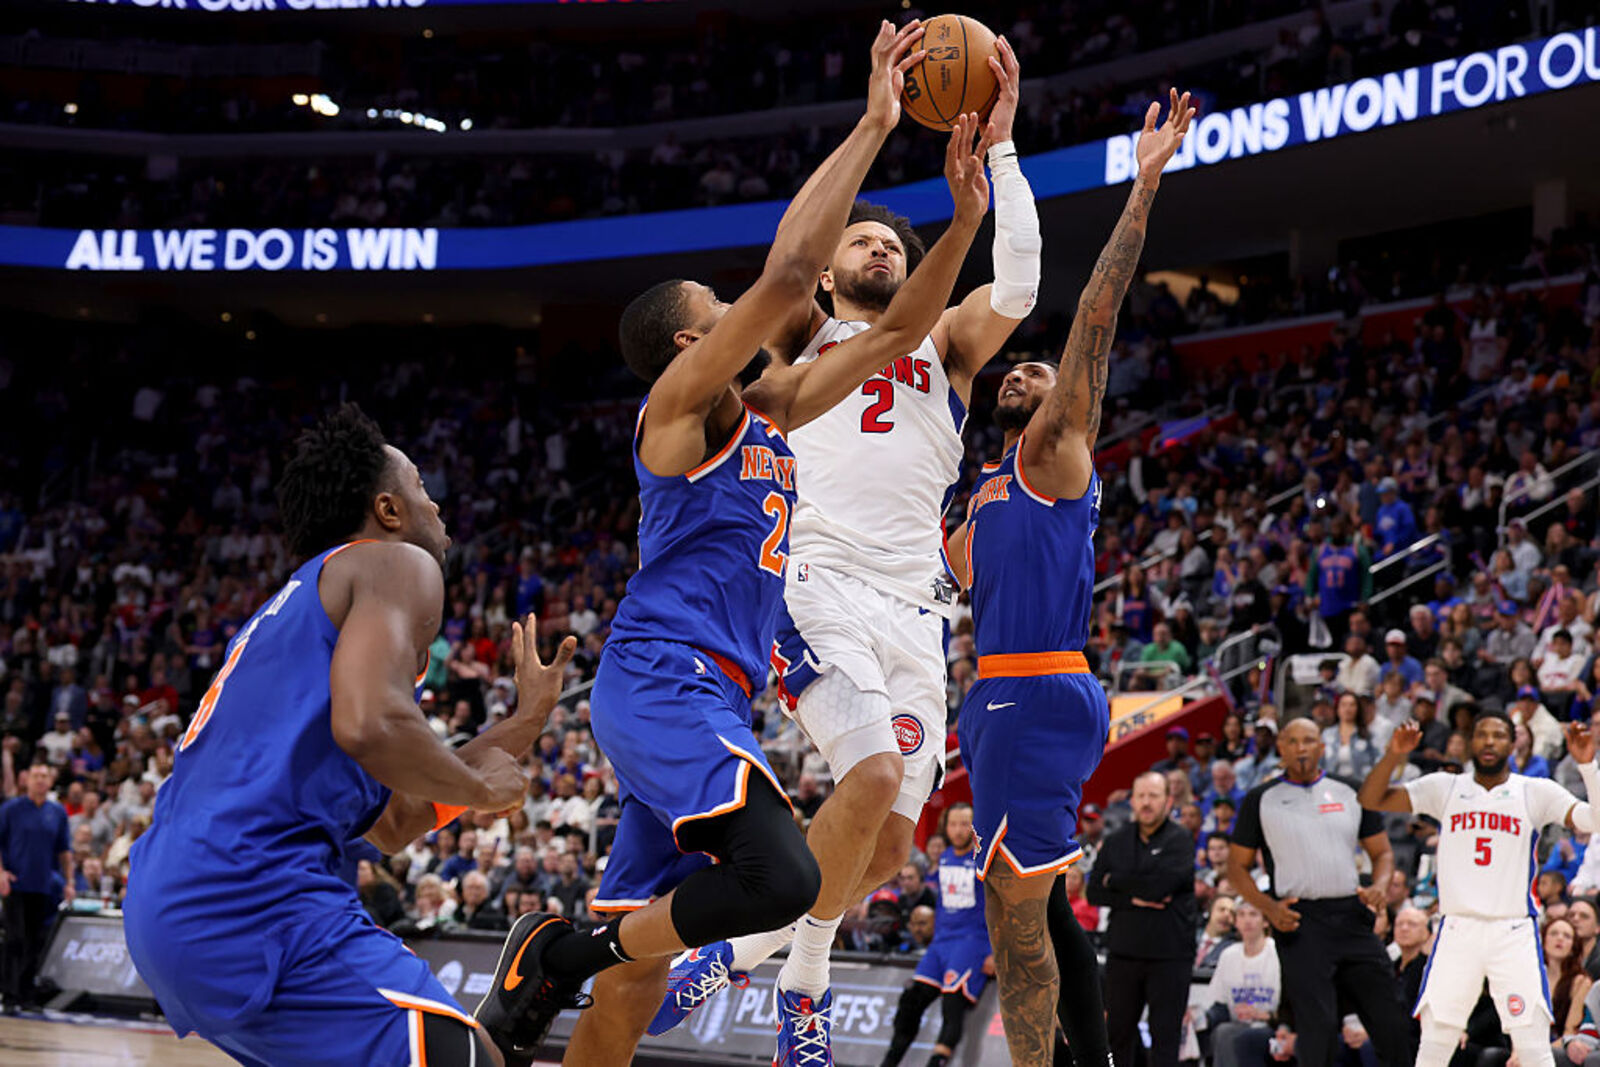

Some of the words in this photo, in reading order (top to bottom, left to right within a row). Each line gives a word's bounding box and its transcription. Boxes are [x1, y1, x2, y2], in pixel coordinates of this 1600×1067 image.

[1105, 98, 1290, 185] BIONS
[1299, 67, 1419, 142] WON
[1431, 45, 1528, 115] FOR
[66, 229, 144, 270] ALL
[153, 229, 217, 270] WE
[224, 228, 294, 270] DO
[302, 228, 338, 270] IS
[347, 228, 438, 270] WIN
[861, 377, 895, 434] 2
[759, 490, 794, 578] 2
[1450, 811, 1522, 837] PISTONS
[1474, 837, 1493, 867] 5
[735, 986, 889, 1035] PLFFS
